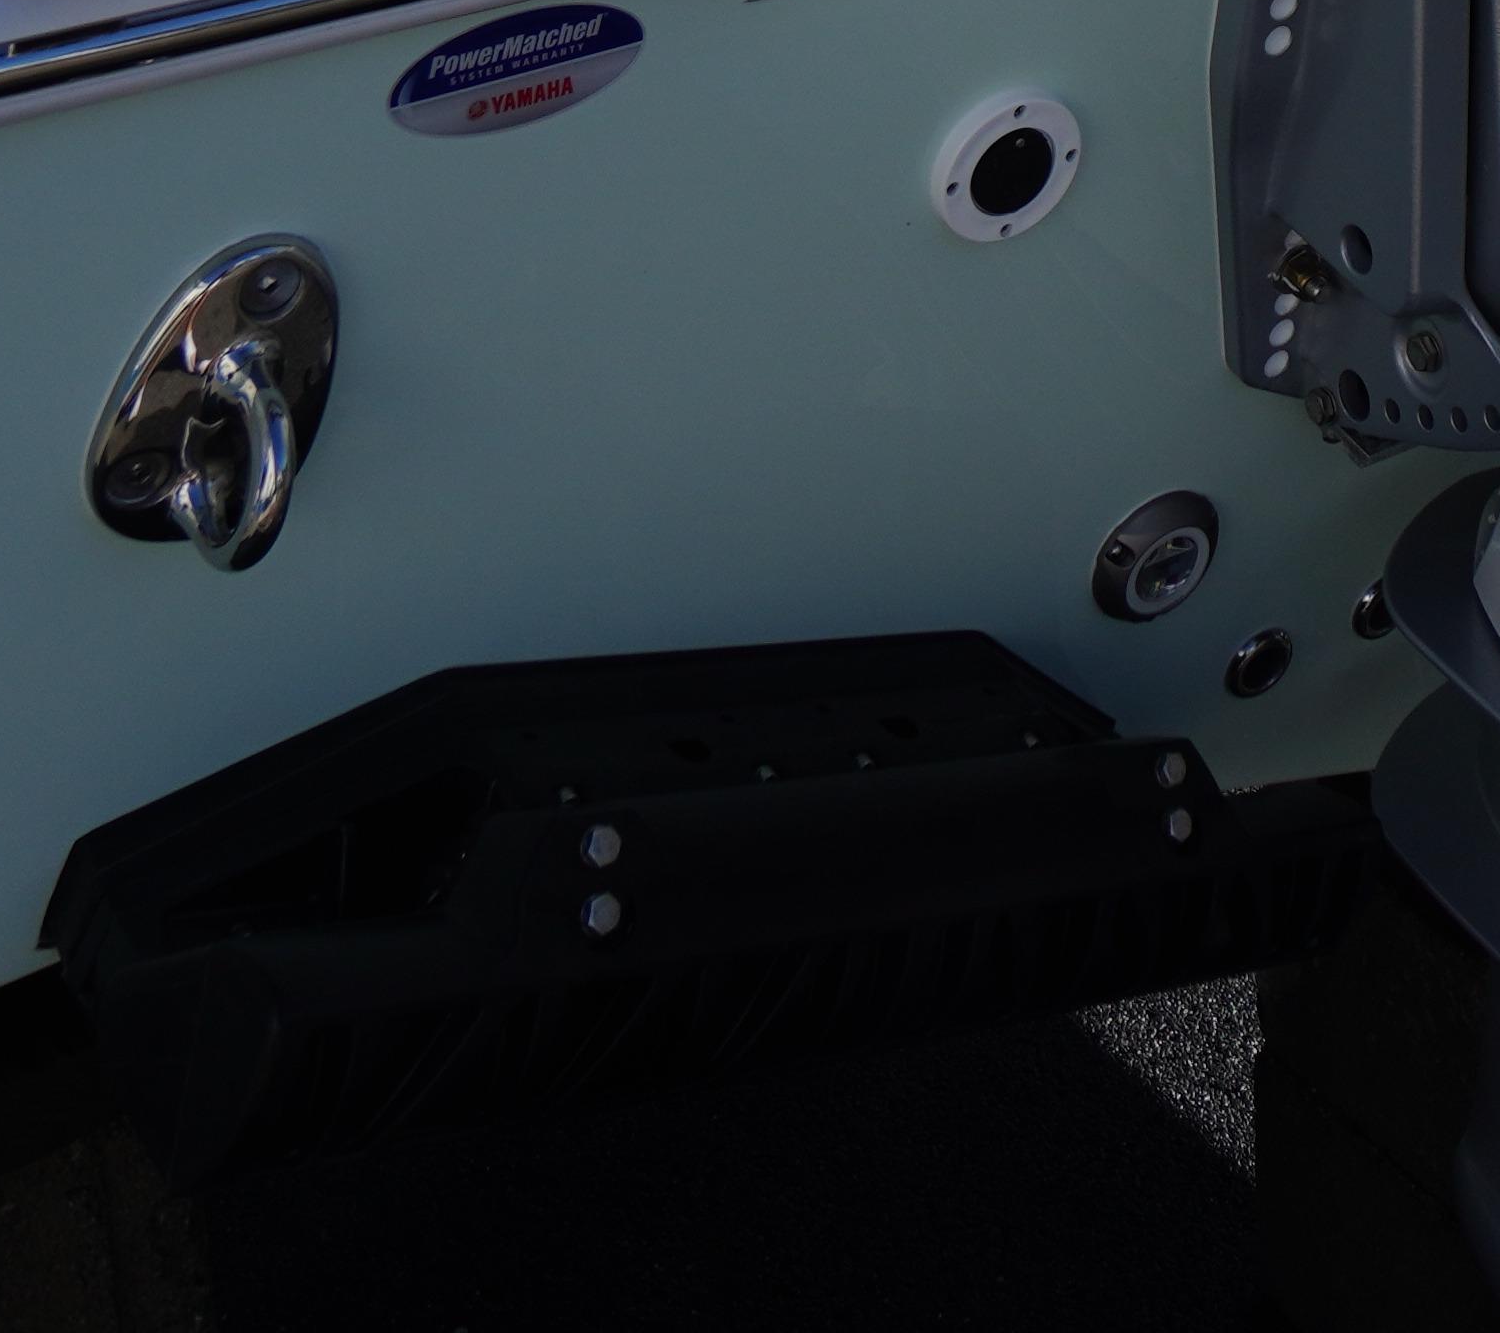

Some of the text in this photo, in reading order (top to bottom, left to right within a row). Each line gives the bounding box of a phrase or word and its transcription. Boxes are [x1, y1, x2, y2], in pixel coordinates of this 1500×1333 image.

[450, 43, 585, 86] SYSTEM WARRANTY
[491, 76, 573, 115] YAMAHA
